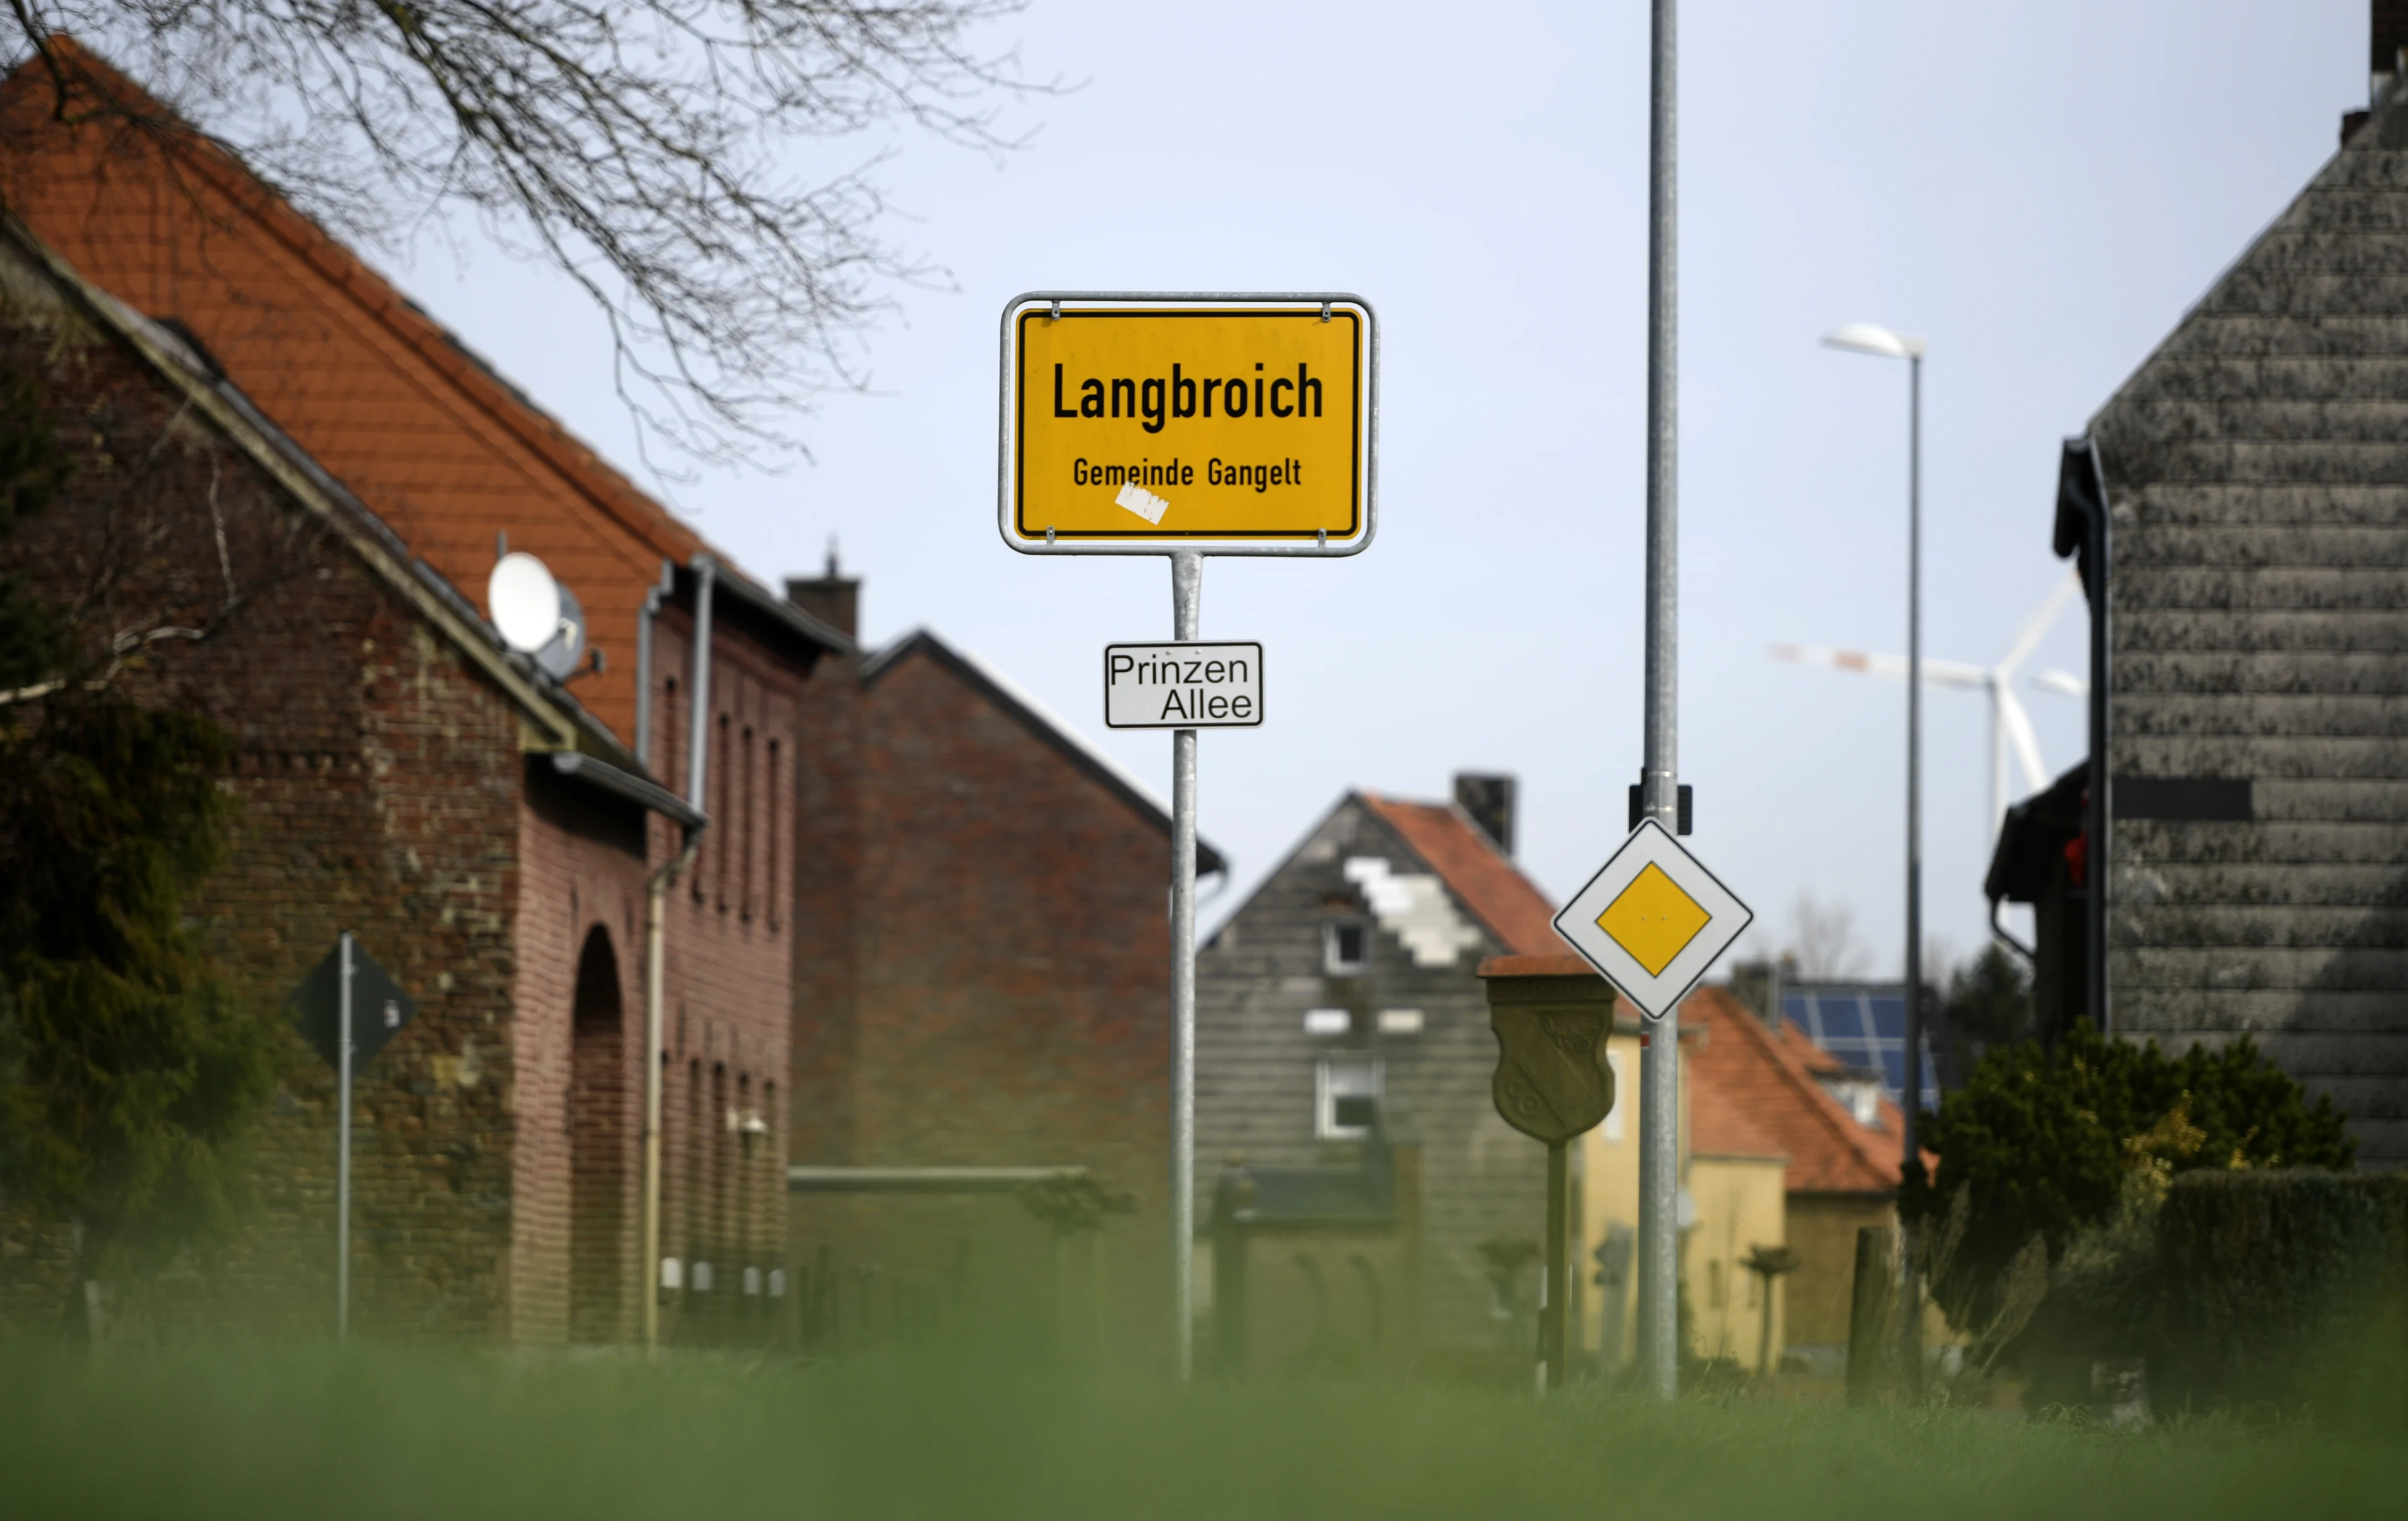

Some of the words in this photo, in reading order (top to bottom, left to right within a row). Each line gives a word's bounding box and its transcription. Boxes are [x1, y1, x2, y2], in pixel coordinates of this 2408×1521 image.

[1054, 362, 1323, 434] Langbroich
[1074, 457, 1193, 485] Gemeinde
[1208, 457, 1301, 493] Gangelt
[1111, 654, 1247, 685] Prinzen
[1160, 688, 1252, 719] Allee
